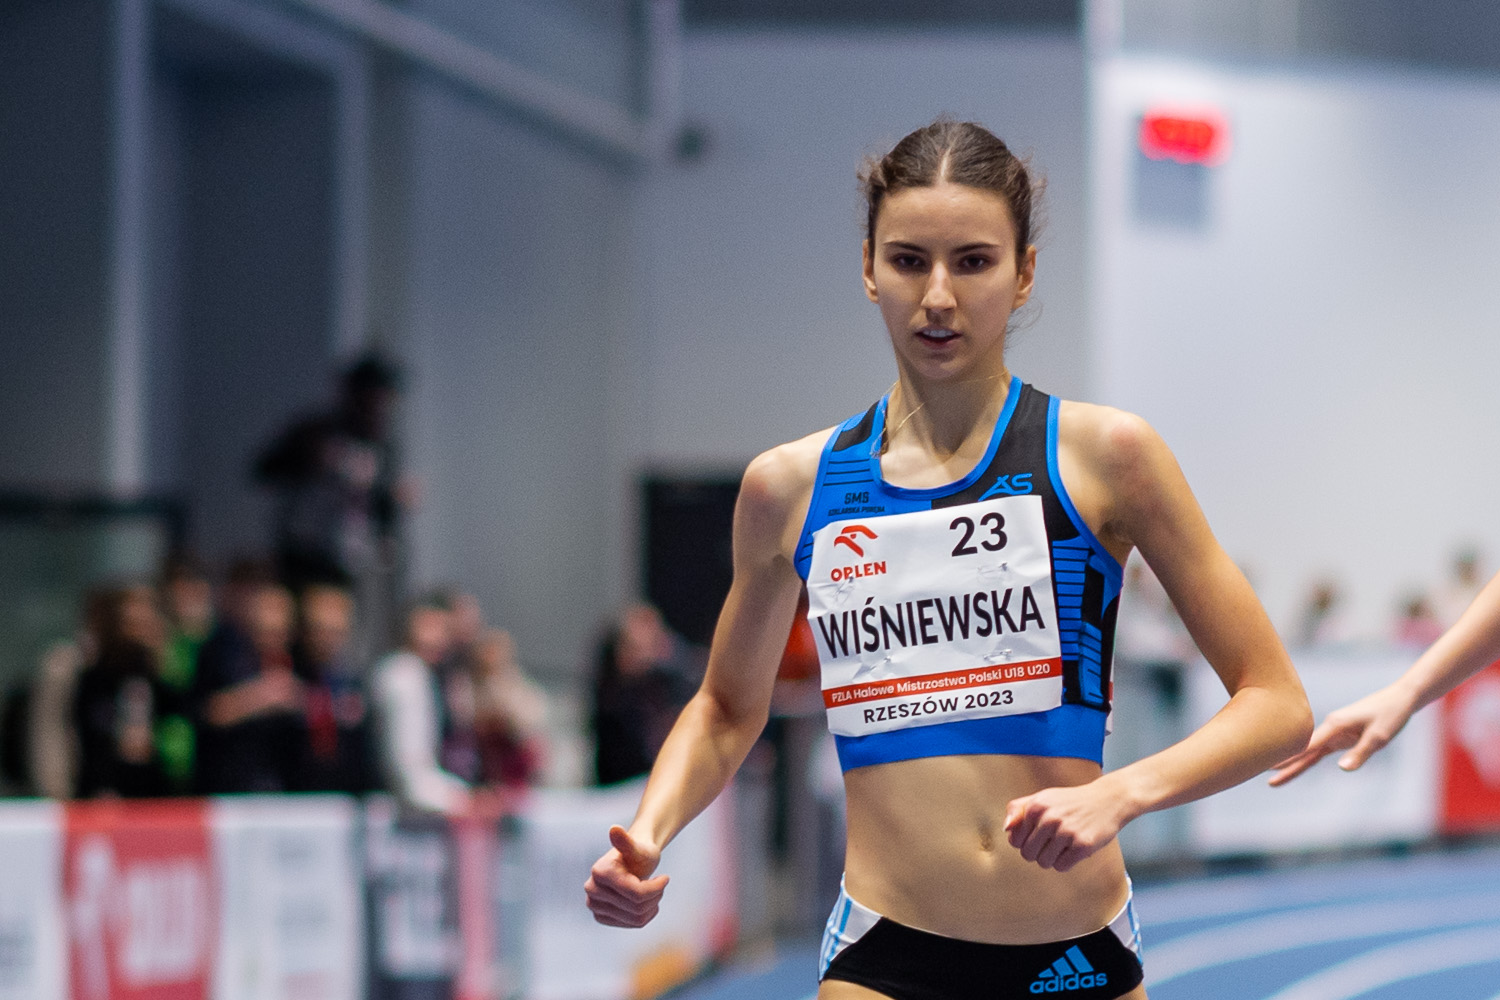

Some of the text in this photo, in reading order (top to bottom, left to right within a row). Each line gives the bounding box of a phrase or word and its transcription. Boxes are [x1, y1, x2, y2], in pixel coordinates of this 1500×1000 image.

[844, 491, 869, 505] SMS
[949, 512, 1008, 557] 23
[830, 560, 887, 583] ORLEN
[817, 585, 1046, 659] WIŚNIEWSKA
[831, 663, 1050, 702] PZLA Halowe Mistrzostwa Polski U18 U20
[863, 689, 1014, 725] RZESZÓW 2023
[1029, 972, 1108, 994] adidas
